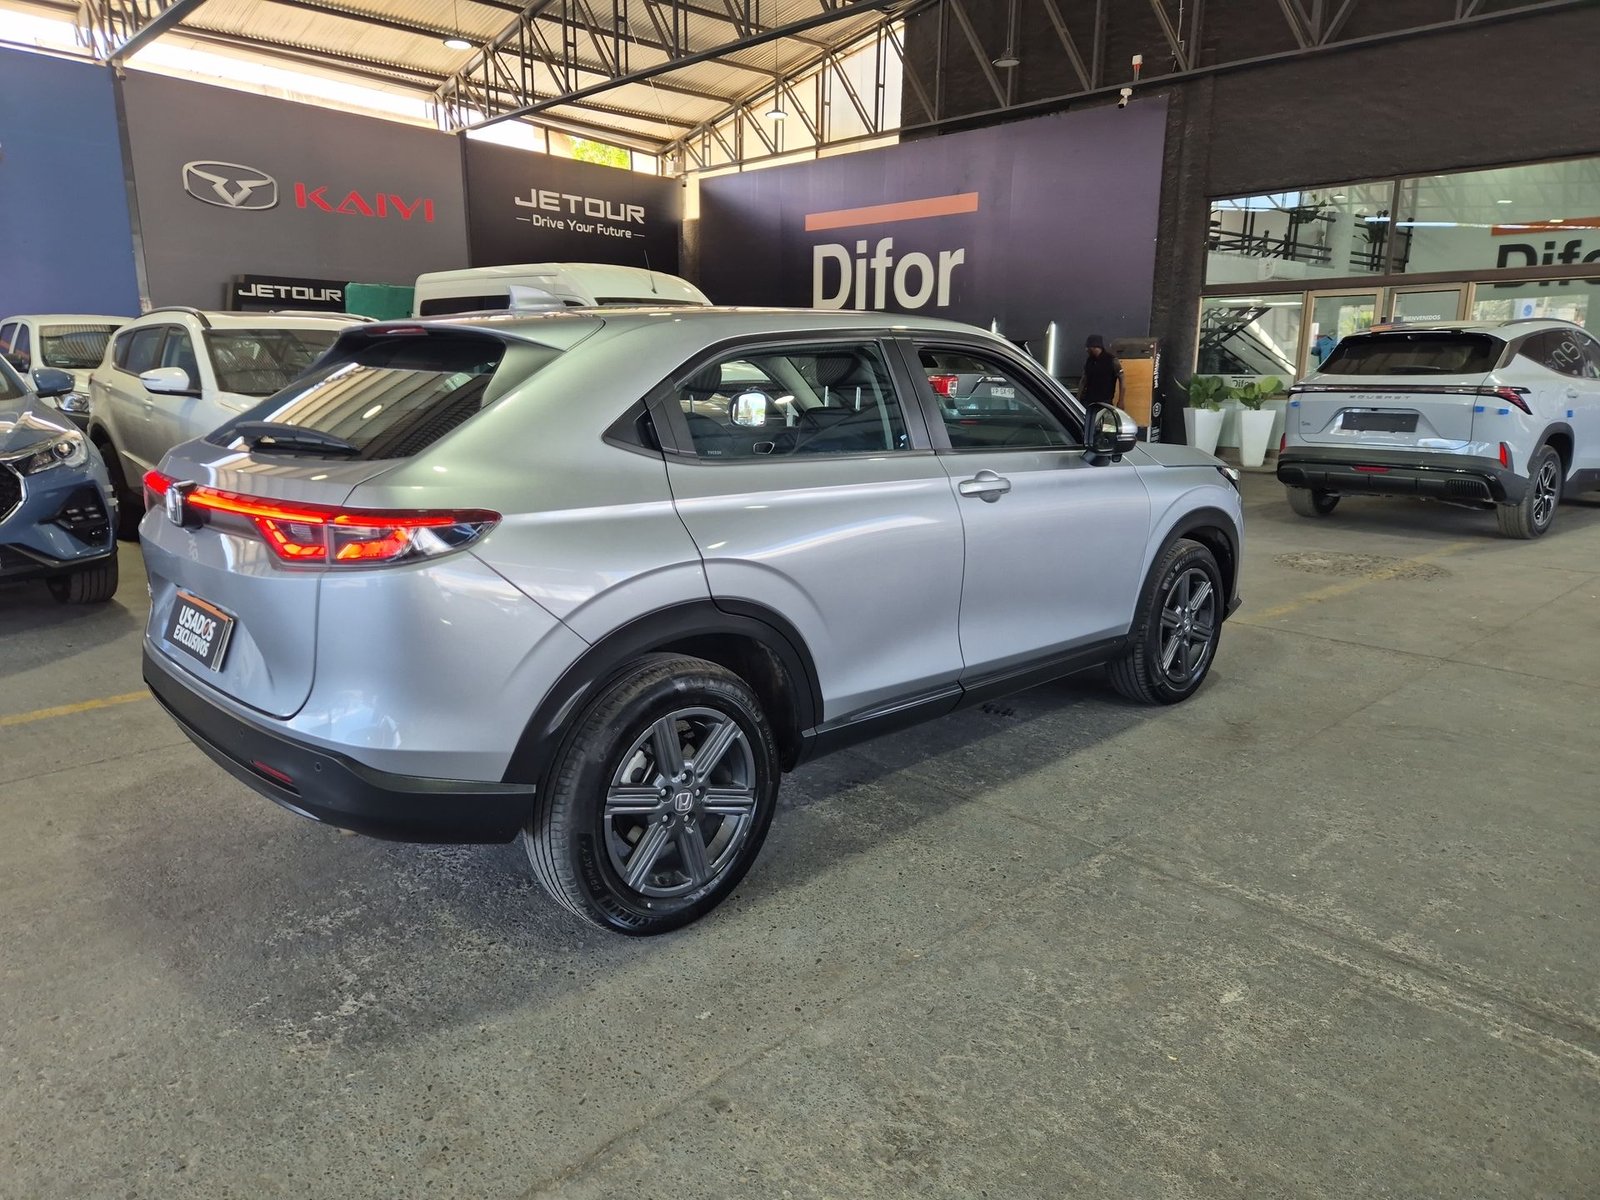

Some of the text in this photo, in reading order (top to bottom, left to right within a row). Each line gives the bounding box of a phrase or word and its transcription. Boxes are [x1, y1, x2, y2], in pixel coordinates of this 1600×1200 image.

[294, 182, 434, 223] KAIYI
[514, 188, 645, 225] JETOUR
[532, 214, 632, 239] Drive Your Future
[812, 237, 965, 310] Difor
[238, 283, 342, 302] JETOUR
[173, 624, 210, 658] EXCLUSIVOS
[179, 605, 217, 642] USADOS
